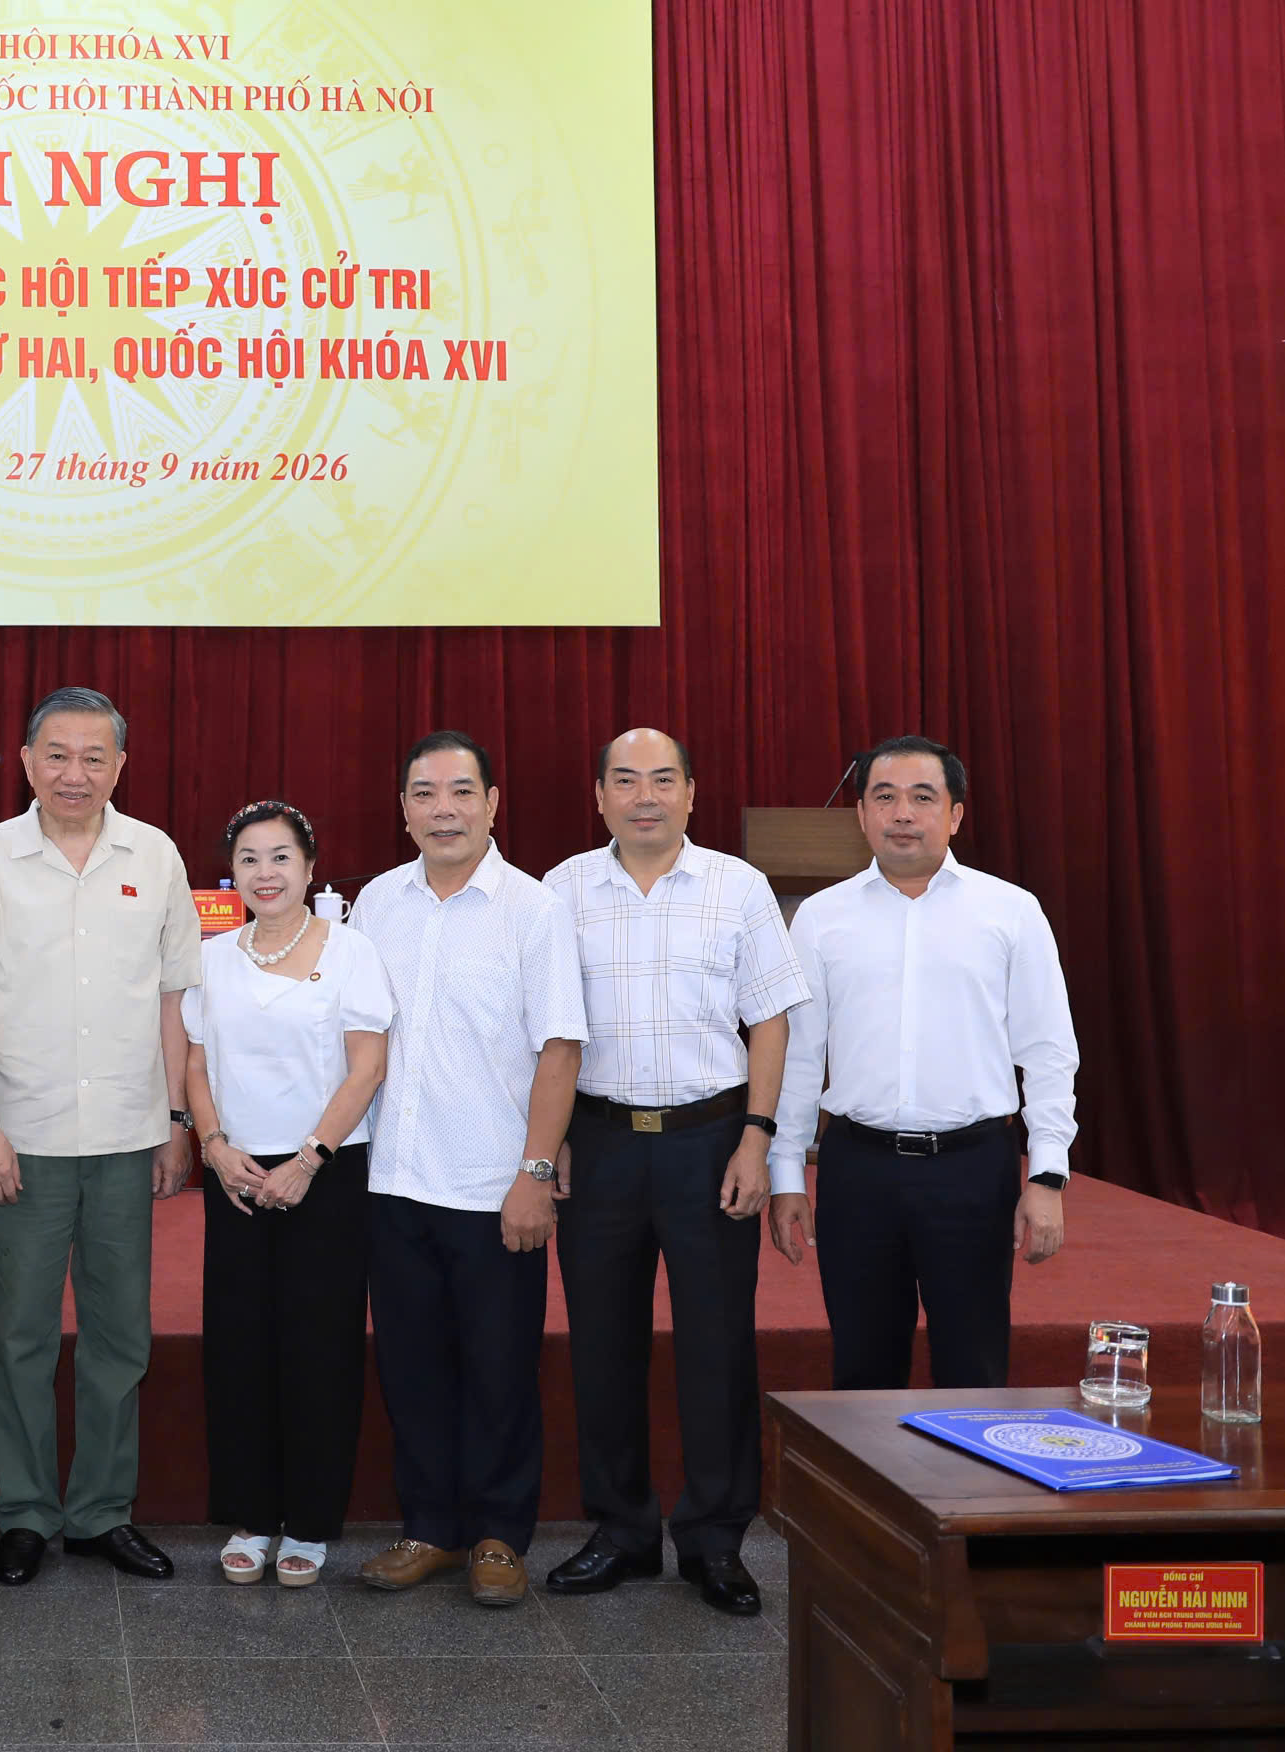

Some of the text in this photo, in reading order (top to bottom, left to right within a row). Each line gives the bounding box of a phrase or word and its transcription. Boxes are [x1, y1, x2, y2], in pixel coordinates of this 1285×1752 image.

[68, 27, 164, 60] KHÓA
[174, 35, 231, 60] XVI
[48, 78, 109, 117] HỘI
[118, 77, 234, 111] THÀNH
[244, 75, 311, 112] PHỐ
[320, 79, 366, 112] HÀ
[375, 80, 435, 120] NỘI
[44, 150, 281, 225] NGHỊ
[21, 257, 89, 317] HỘI
[102, 251, 191, 308] TIẾP
[205, 258, 287, 309] XÚC
[301, 249, 361, 310] CỬ
[368, 268, 431, 311] TRI
[19, 336, 99, 385] HAI,
[113, 322, 223, 384] QUỐC
[237, 328, 305, 389] HỘI
[319, 329, 430, 381] KHÓA
[443, 339, 508, 382] XVI
[6, 452, 45, 481] 27
[56, 452, 149, 487] tháng
[160, 452, 179, 480] 9
[190, 453, 260, 481] năm
[270, 453, 348, 481] 2026
[1119, 1584, 1248, 1608] NGUYỄN HẢI NINH
